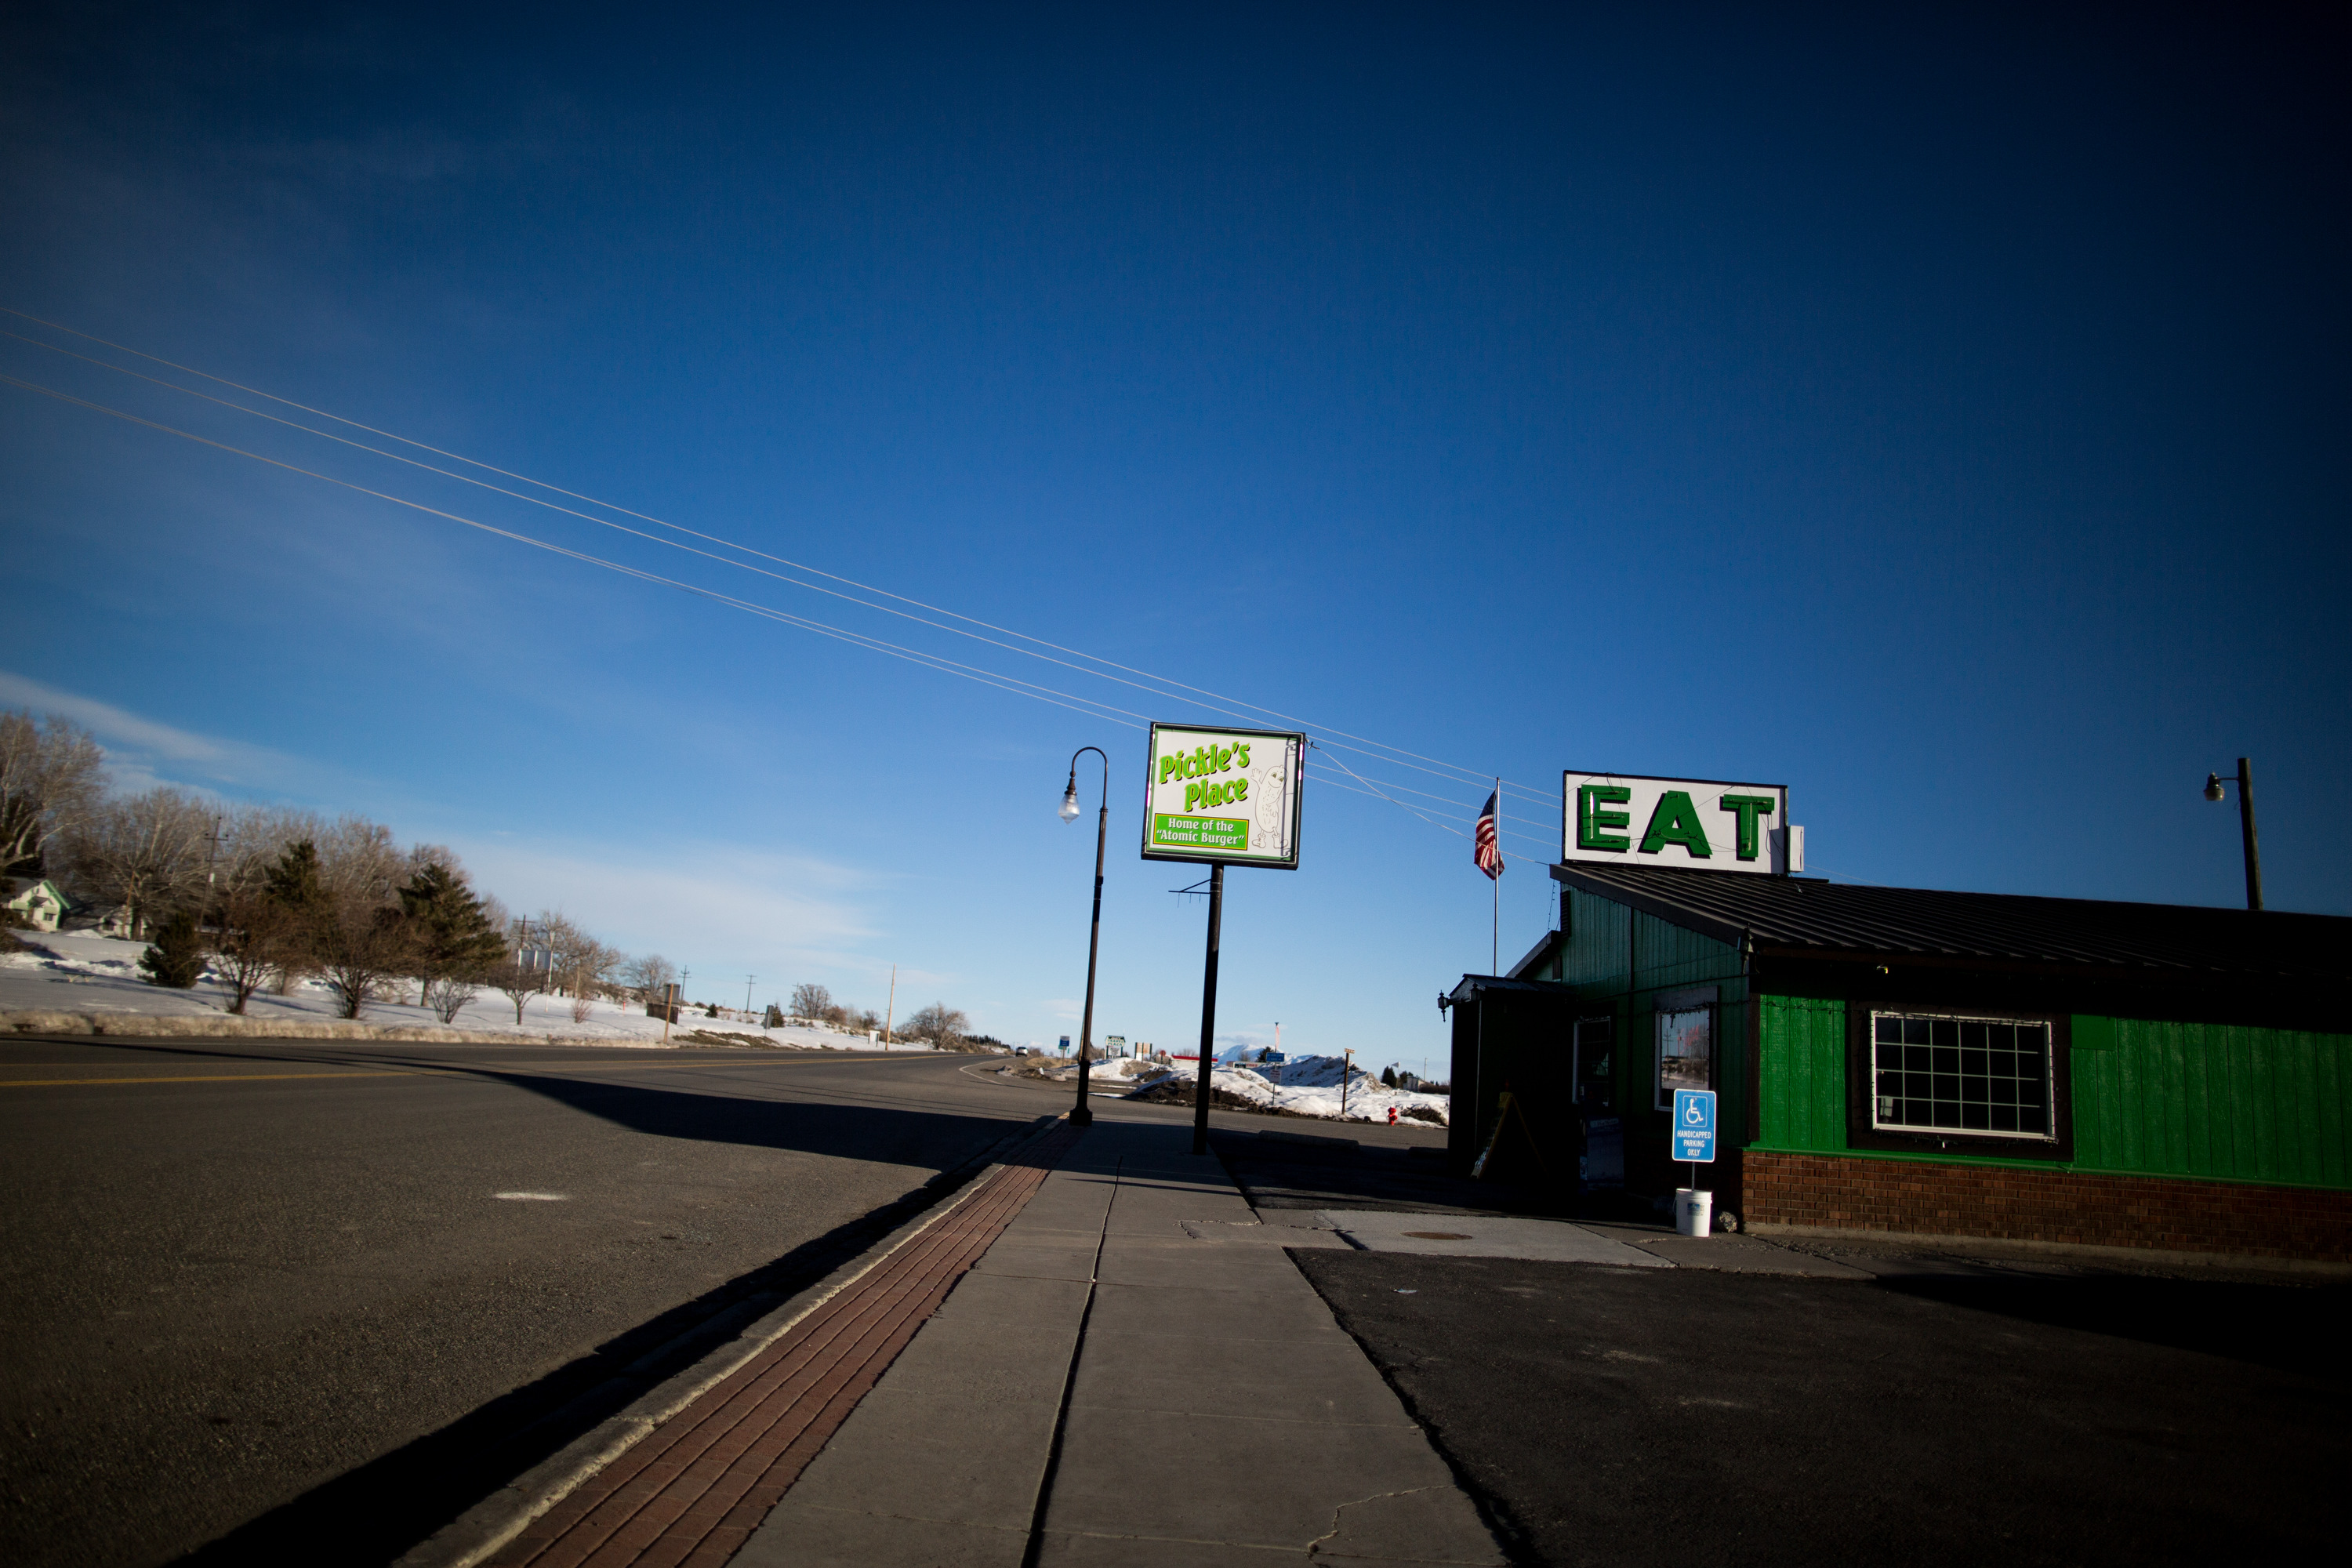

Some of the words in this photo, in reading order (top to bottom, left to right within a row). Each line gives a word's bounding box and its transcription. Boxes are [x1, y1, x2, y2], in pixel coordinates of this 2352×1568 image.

[1158, 741, 1250, 784] Pickle's
[1183, 778, 1249, 812] Place
[1156, 829, 1198, 842] “Atomic
[1201, 832, 1244, 846] Burger”
[1168, 818, 1199, 829] Home
[1202, 820, 1214, 830] of
[1216, 821, 1234, 832] the
[1577, 784, 1775, 862] EAT
